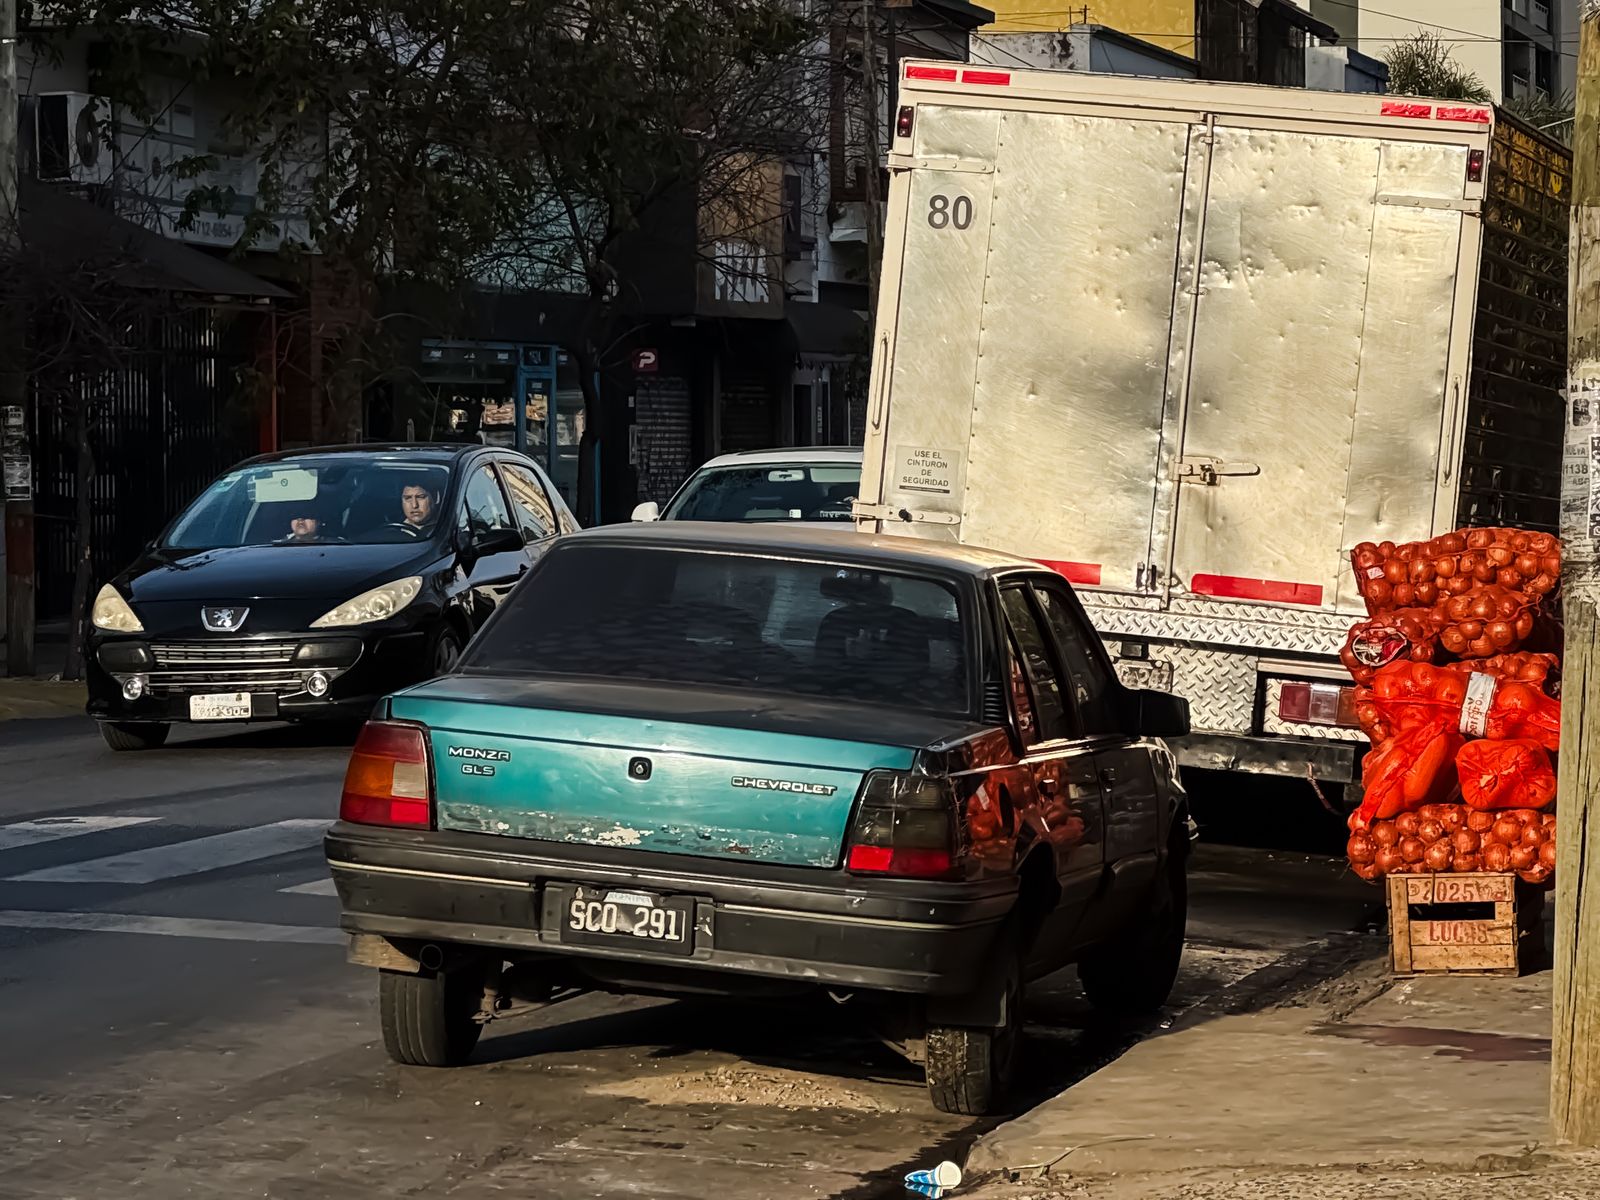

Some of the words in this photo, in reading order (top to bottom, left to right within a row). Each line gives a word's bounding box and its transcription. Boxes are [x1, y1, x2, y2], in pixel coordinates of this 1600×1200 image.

[927, 194, 973, 230] 80
[914, 449, 931, 458] USE
[932, 451, 942, 460] EL
[907, 458, 948, 469] CINTURON
[920, 469, 932, 477] DE
[902, 476, 949, 487] SEGURIDAD
[448, 745, 511, 762] MONZA
[461, 763, 495, 776] GLS
[731, 776, 838, 797] CHEVROLET
[1422, 879, 1474, 902] 2025
[569, 900, 618, 933] SCO
[633, 906, 680, 941] 291
